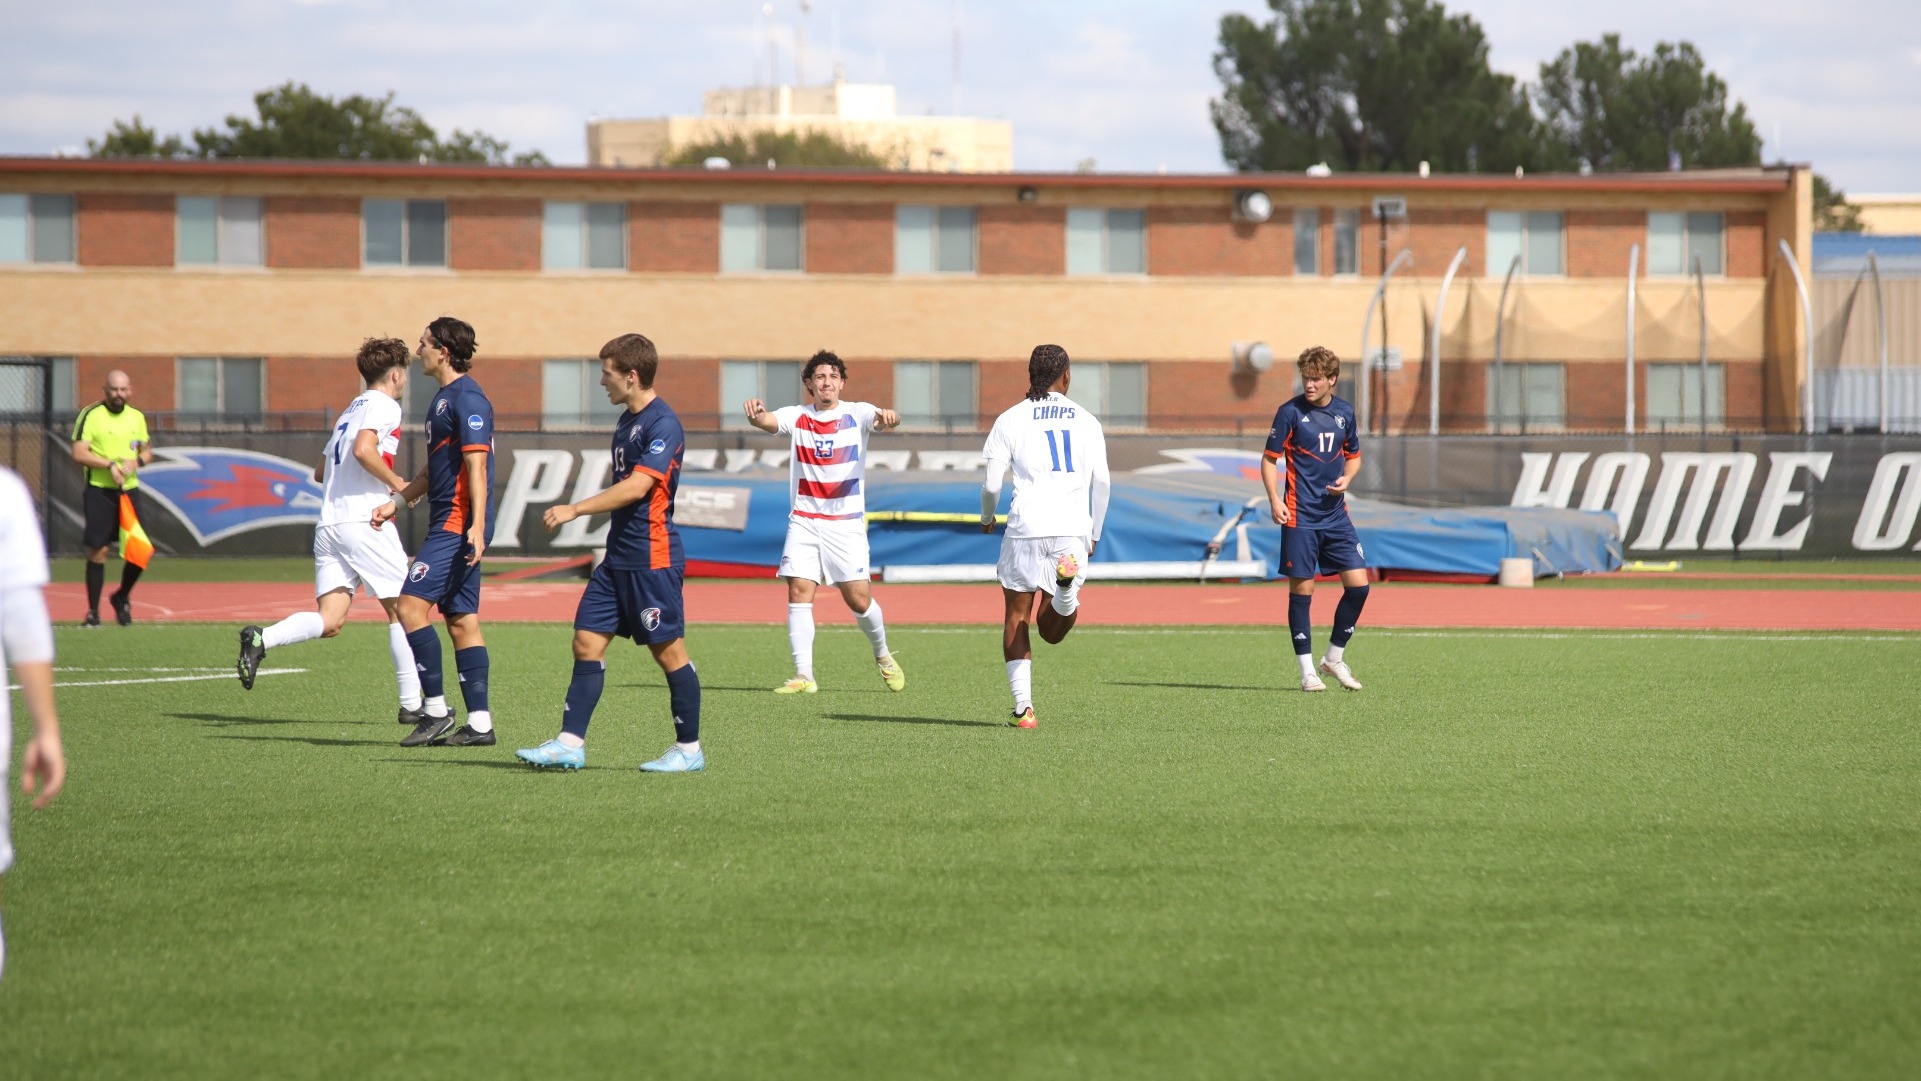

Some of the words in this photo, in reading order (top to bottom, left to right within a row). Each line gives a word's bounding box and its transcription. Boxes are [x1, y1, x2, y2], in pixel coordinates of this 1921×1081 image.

[1032, 405, 1076, 420] CHAPS
[334, 422, 349, 465] 7
[815, 439, 834, 458] 23
[1044, 429, 1076, 473] 11
[1318, 432, 1335, 453] 17
[614, 446, 626, 472] 13
[1510, 451, 1834, 551] HOME
[1851, 451, 1921, 551] O
